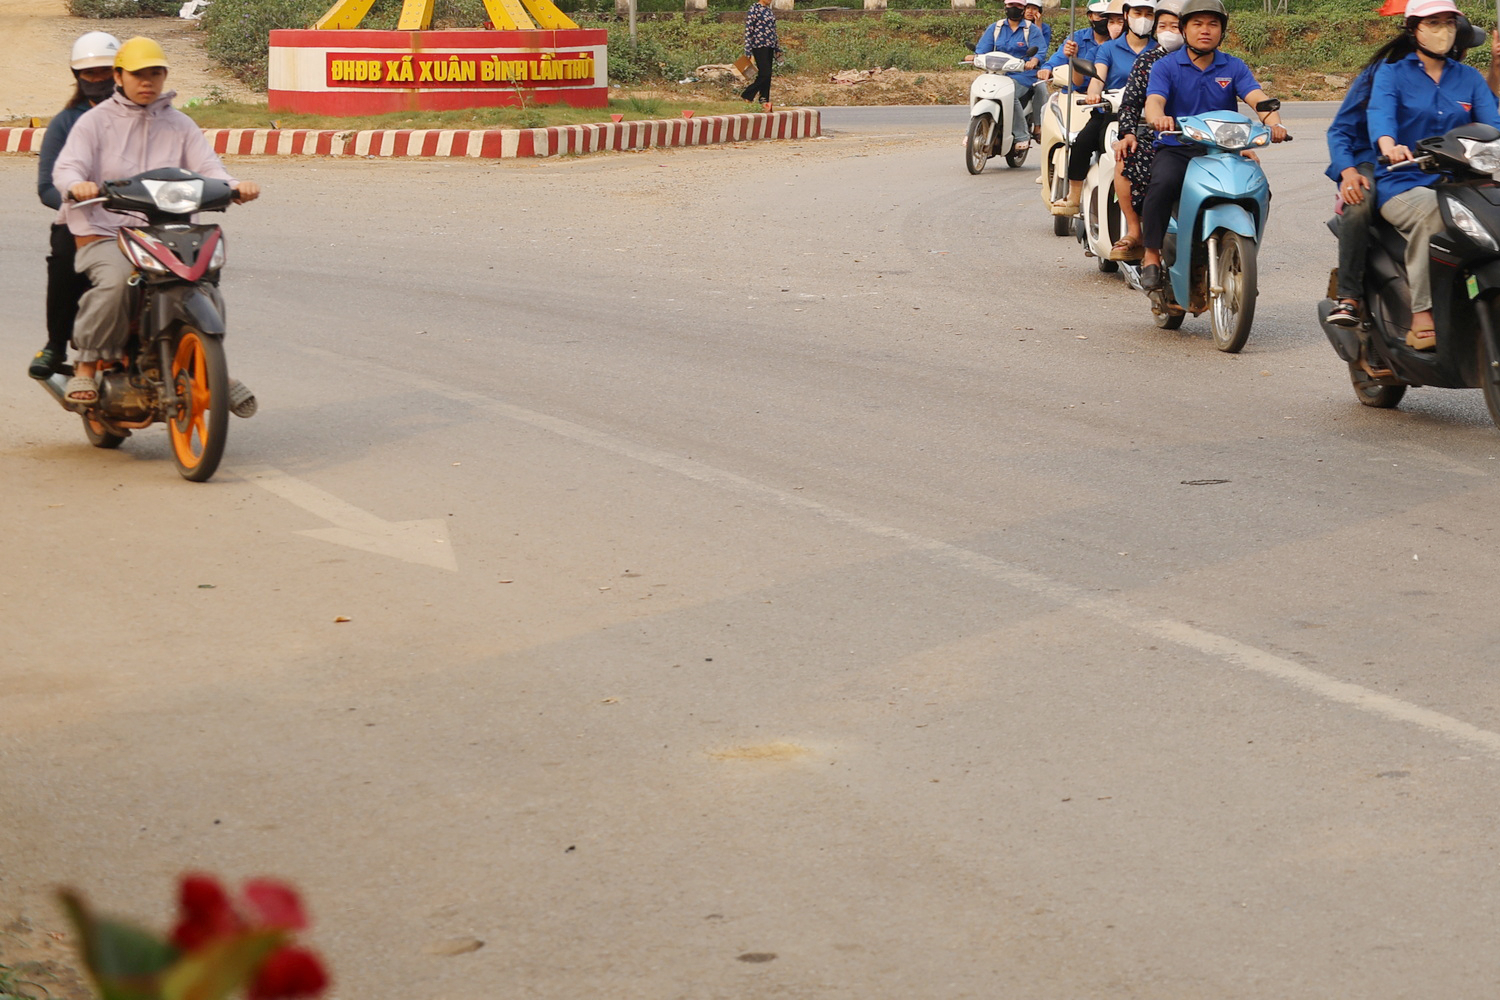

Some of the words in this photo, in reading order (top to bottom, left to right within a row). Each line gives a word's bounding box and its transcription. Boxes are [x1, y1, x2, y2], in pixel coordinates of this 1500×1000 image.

[331, 60, 382, 81] ĐHĐB
[386, 55, 414, 81] XÃ
[419, 55, 476, 81] XUÂN
[480, 55, 528, 81] BÌNH
[530, 52, 564, 80] LẦN
